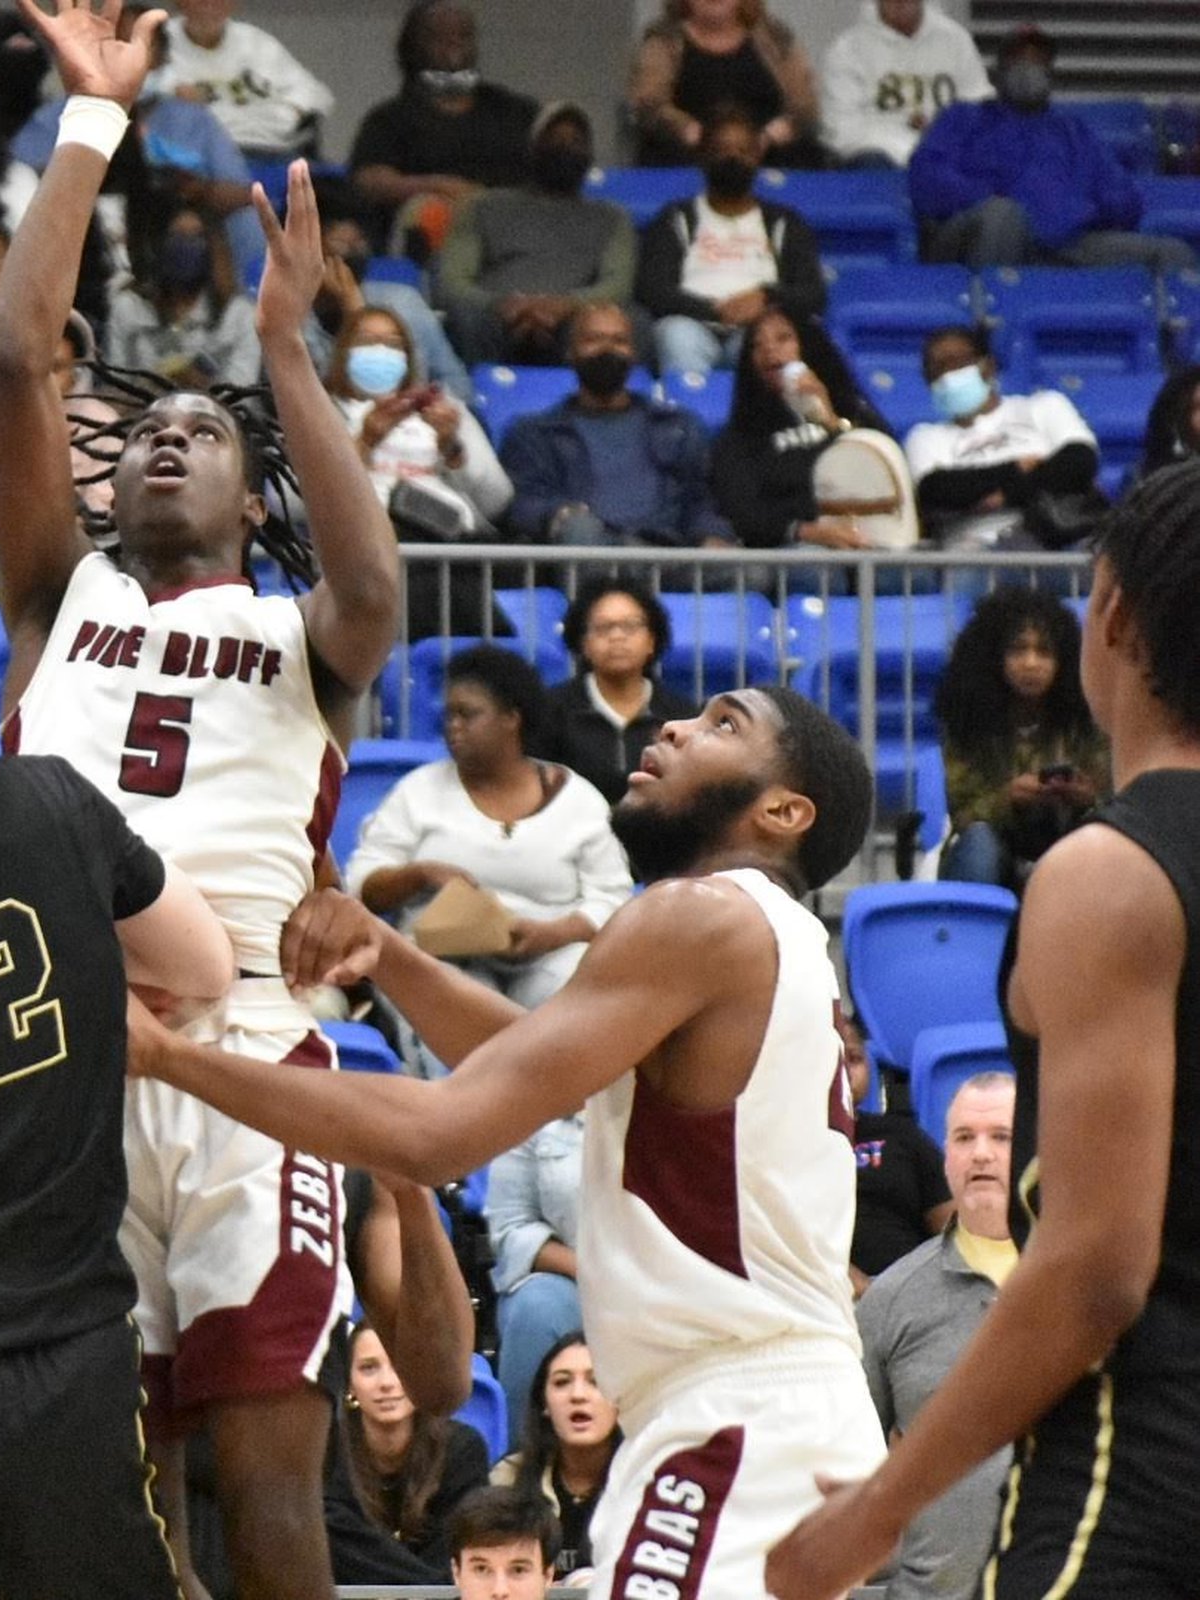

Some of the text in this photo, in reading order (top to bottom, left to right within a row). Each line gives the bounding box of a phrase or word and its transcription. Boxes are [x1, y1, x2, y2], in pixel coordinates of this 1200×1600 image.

[875, 71, 957, 112] 810
[160, 631, 282, 686] BLUFF
[118, 691, 194, 798] 5
[623, 1474, 706, 1600] BRAS
